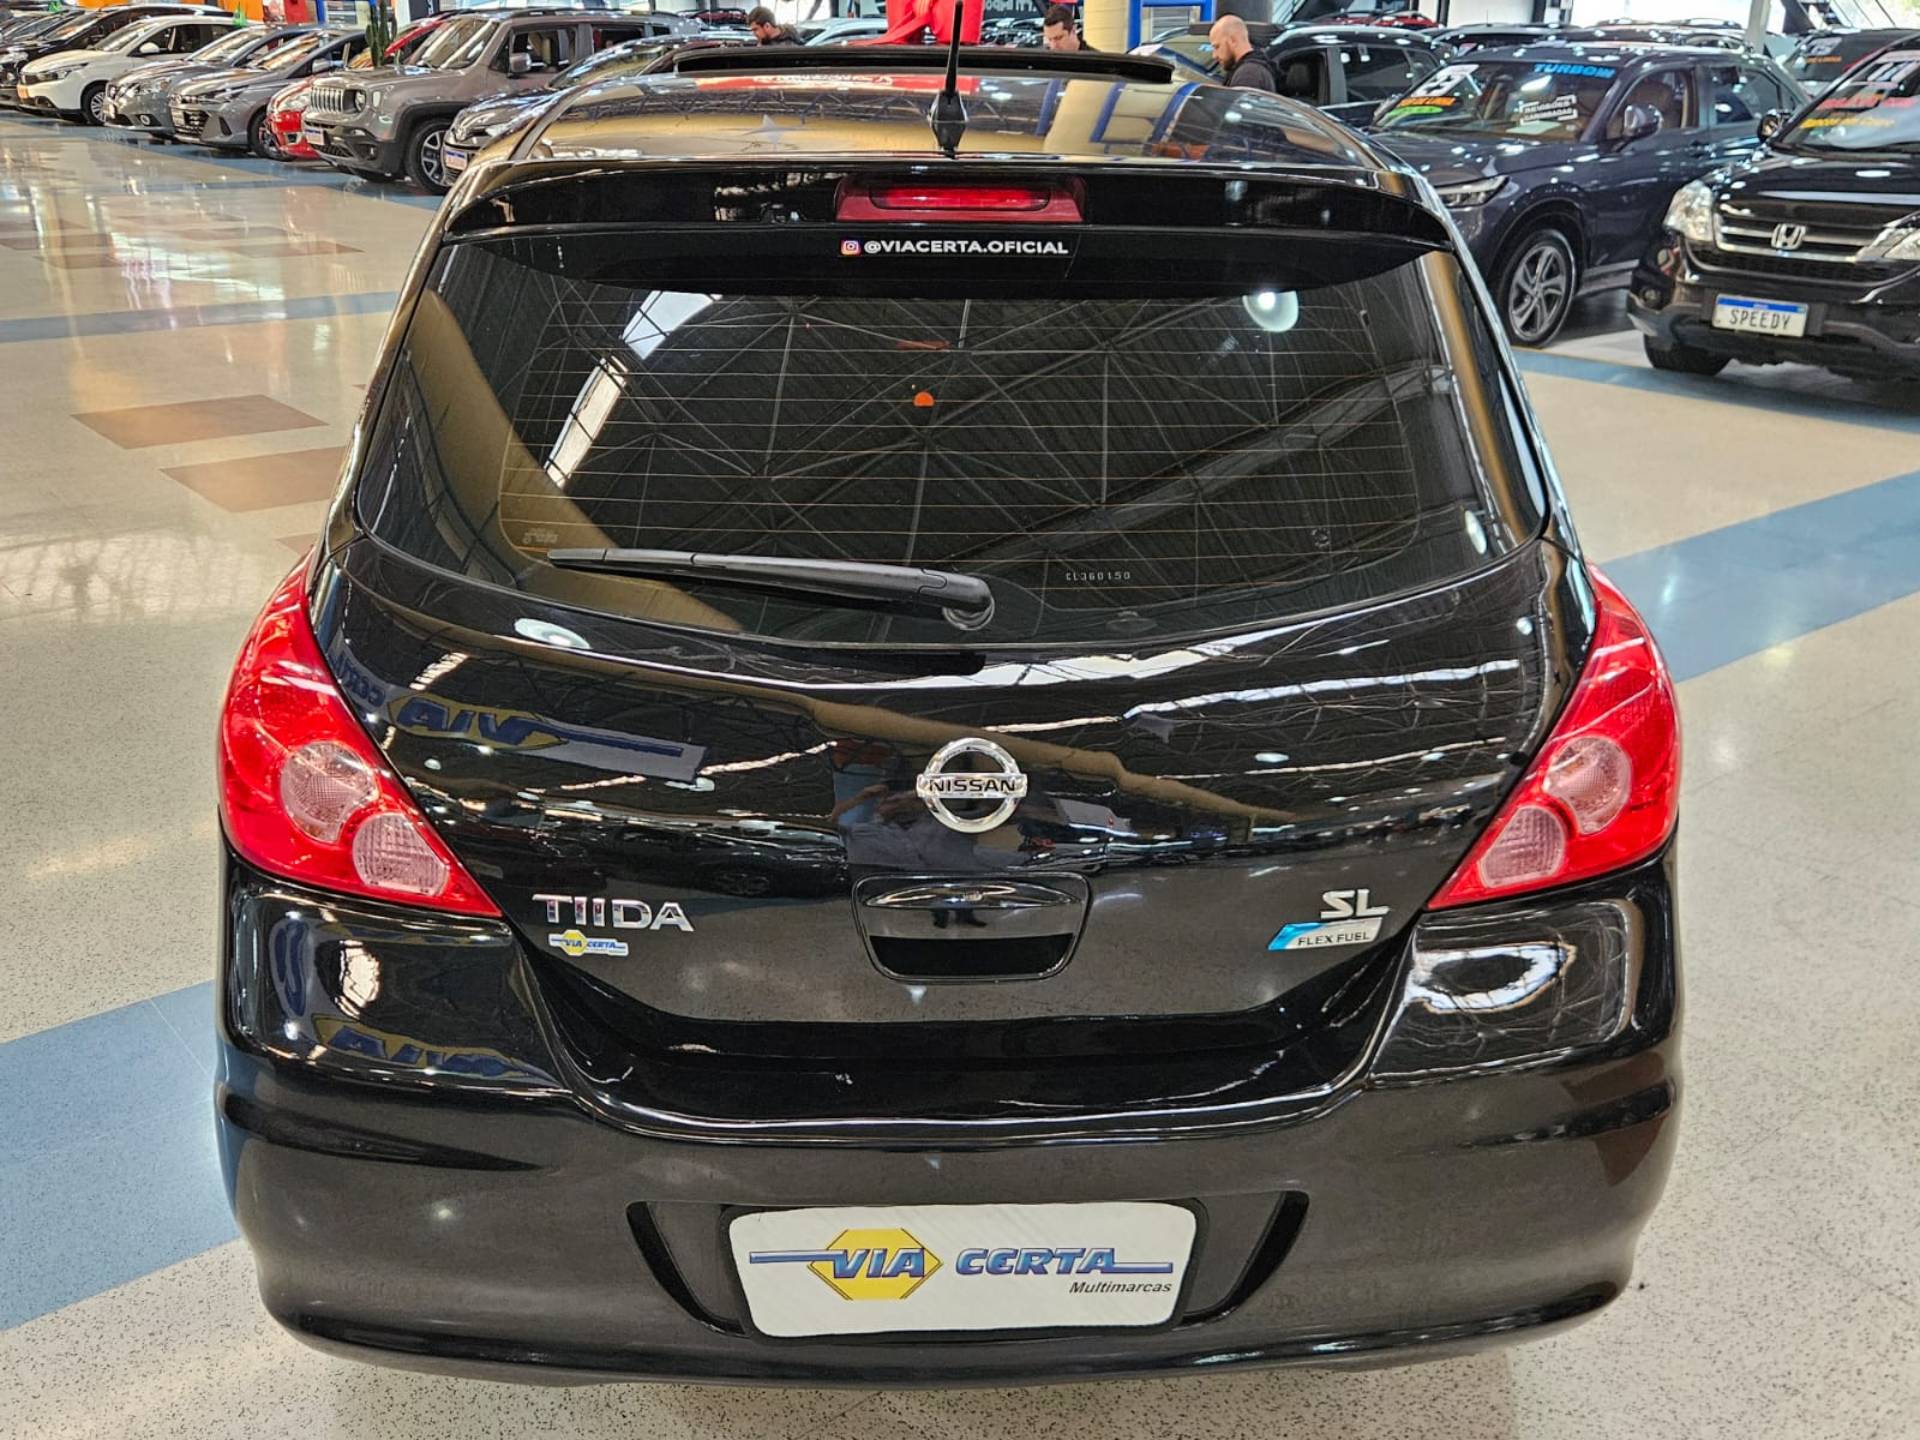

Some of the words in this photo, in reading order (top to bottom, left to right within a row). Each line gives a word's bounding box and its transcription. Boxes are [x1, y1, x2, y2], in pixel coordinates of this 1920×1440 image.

[864, 240, 1069, 255] @VIACERTA.OFICIAL
[1729, 308, 1791, 330] SPEEDY
[929, 780, 1016, 792] NISSAN
[1320, 888, 1390, 919] SL
[532, 894, 694, 932] TIIDA
[1298, 936, 1333, 946] FLEX
[1337, 931, 1370, 943] FUEL
[833, 1248, 925, 1278] VIA
[956, 1247, 1115, 1275] CERTA
[1068, 1281, 1172, 1294] Multimarcas
